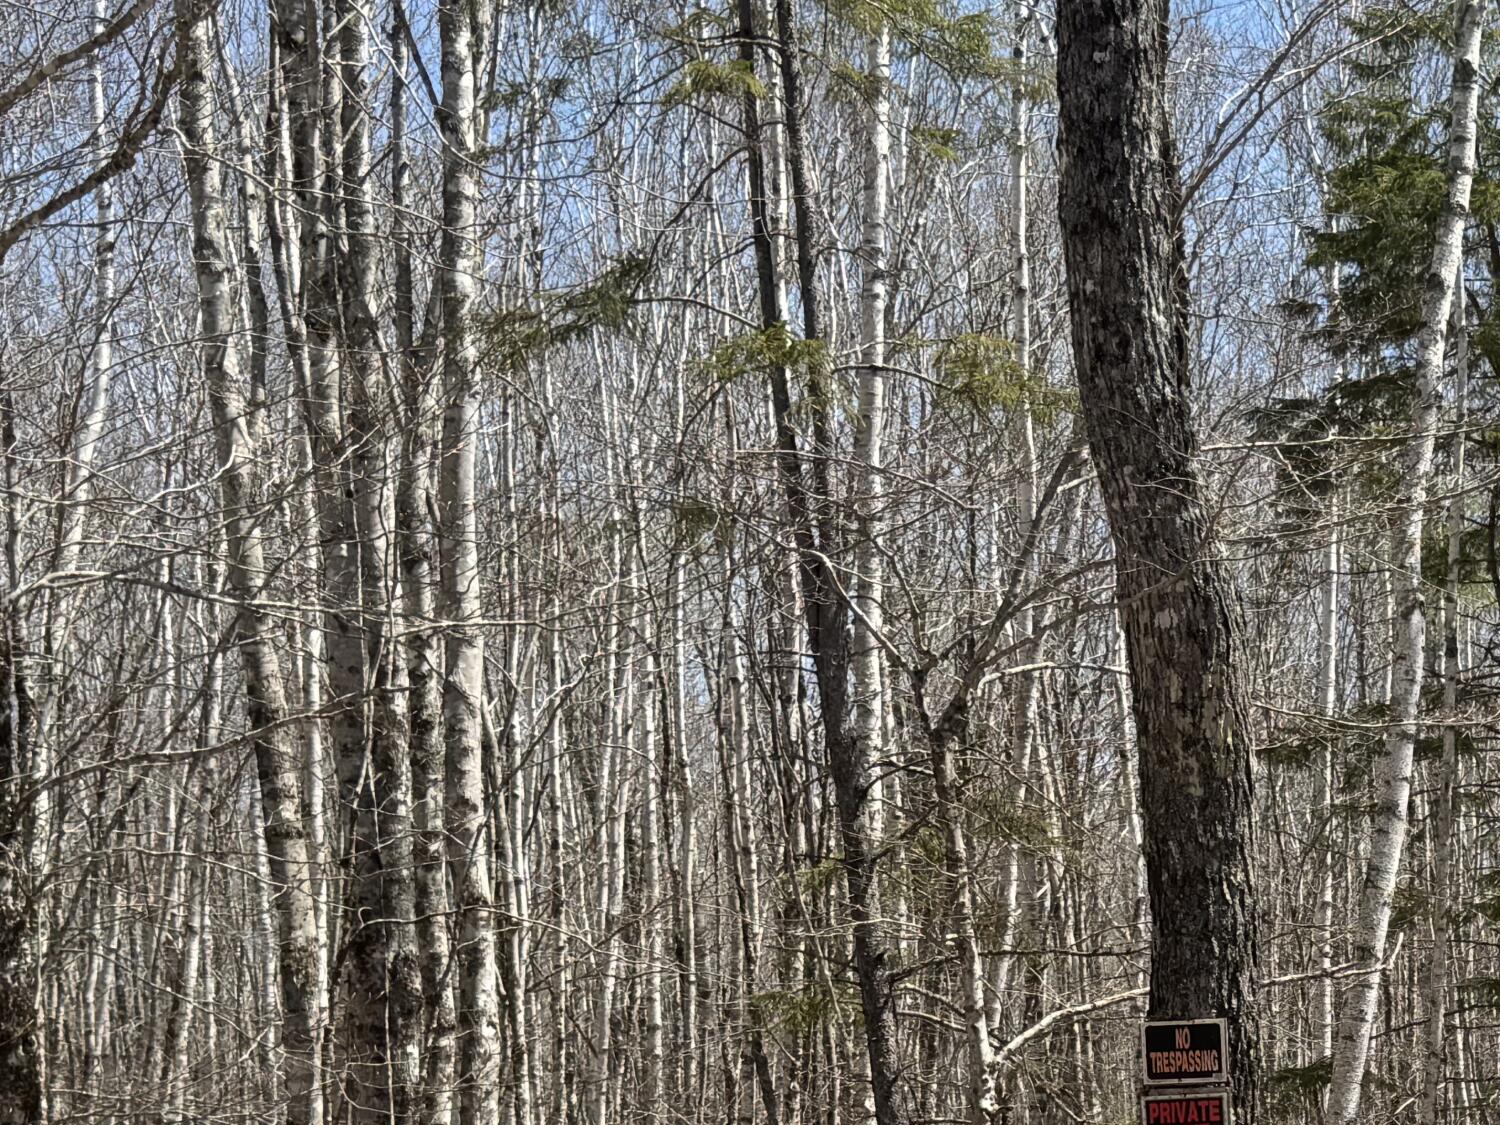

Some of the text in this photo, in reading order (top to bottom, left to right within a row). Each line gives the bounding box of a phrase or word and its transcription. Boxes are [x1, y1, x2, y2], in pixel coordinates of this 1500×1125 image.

[1175, 1026, 1191, 1049] NO
[1150, 1049, 1219, 1073] TRESPASSING
[1149, 1100, 1221, 1124] PRIVATE
